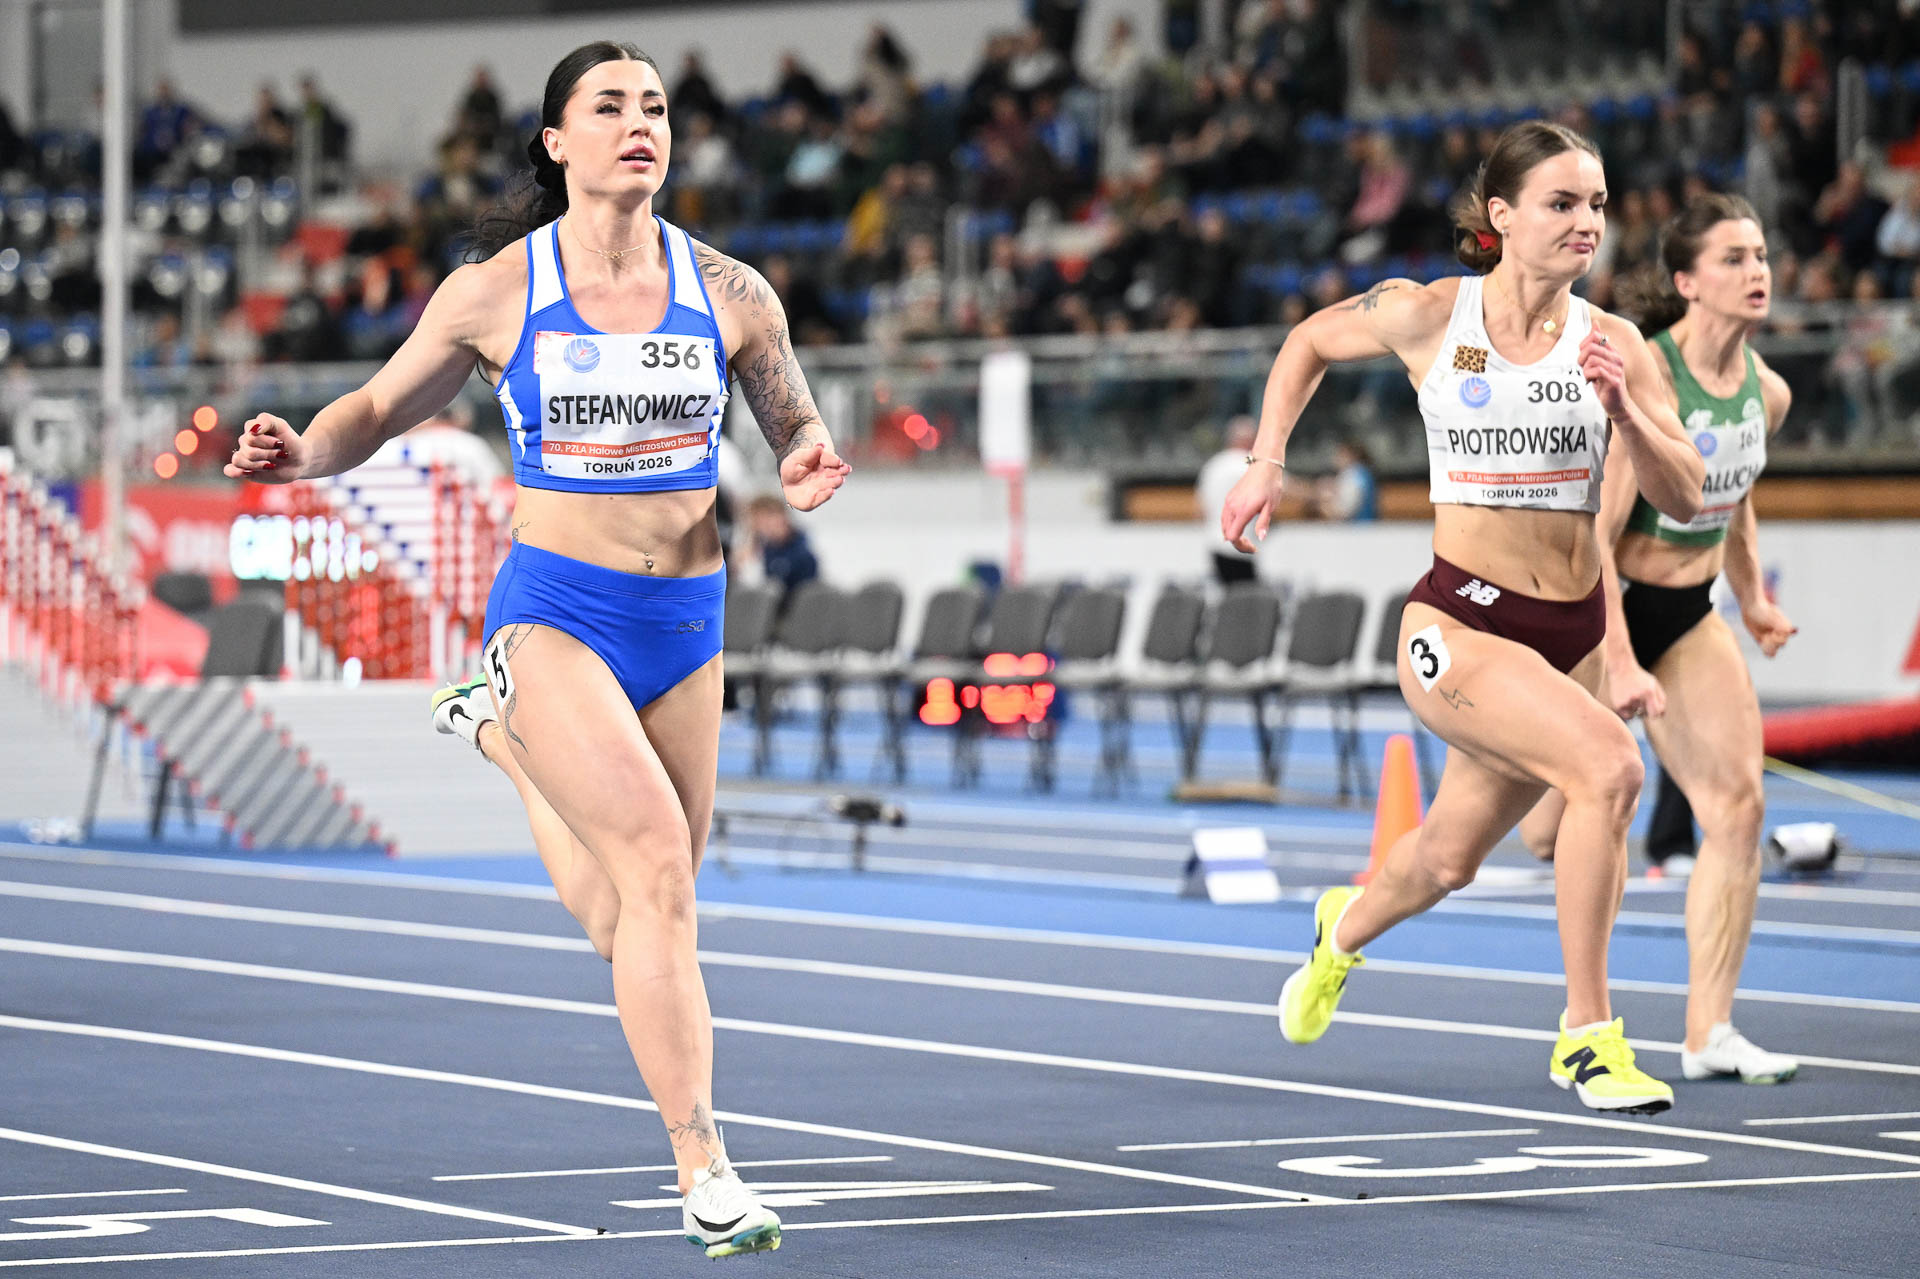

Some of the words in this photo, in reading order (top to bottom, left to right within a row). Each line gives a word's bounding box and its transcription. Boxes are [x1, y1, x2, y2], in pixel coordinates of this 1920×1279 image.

[641, 342, 701, 370] 356
[1527, 381, 1582, 403] 308
[548, 394, 711, 425] STEFANOWICZ
[550, 443, 563, 452] 70.
[565, 444, 587, 454] PZLA
[589, 446, 624, 456] Halowe
[625, 440, 677, 454] Mistrzostwa
[677, 434, 702, 446] Polski
[1448, 426, 1588, 455] PIOTROWSKA
[583, 459, 635, 474] TORUŃ
[638, 456, 673, 471] 2026
[1483, 474, 1514, 483] Halowe
[1515, 471, 1562, 483] Mistrzostwa
[1563, 471, 1584, 480] Polski
[1701, 463, 1759, 493] ALUCH
[1481, 486, 1525, 499] TORUŃ
[1528, 487, 1558, 498] 2026
[491, 645, 507, 698] 5
[1411, 638, 1438, 679] 3
